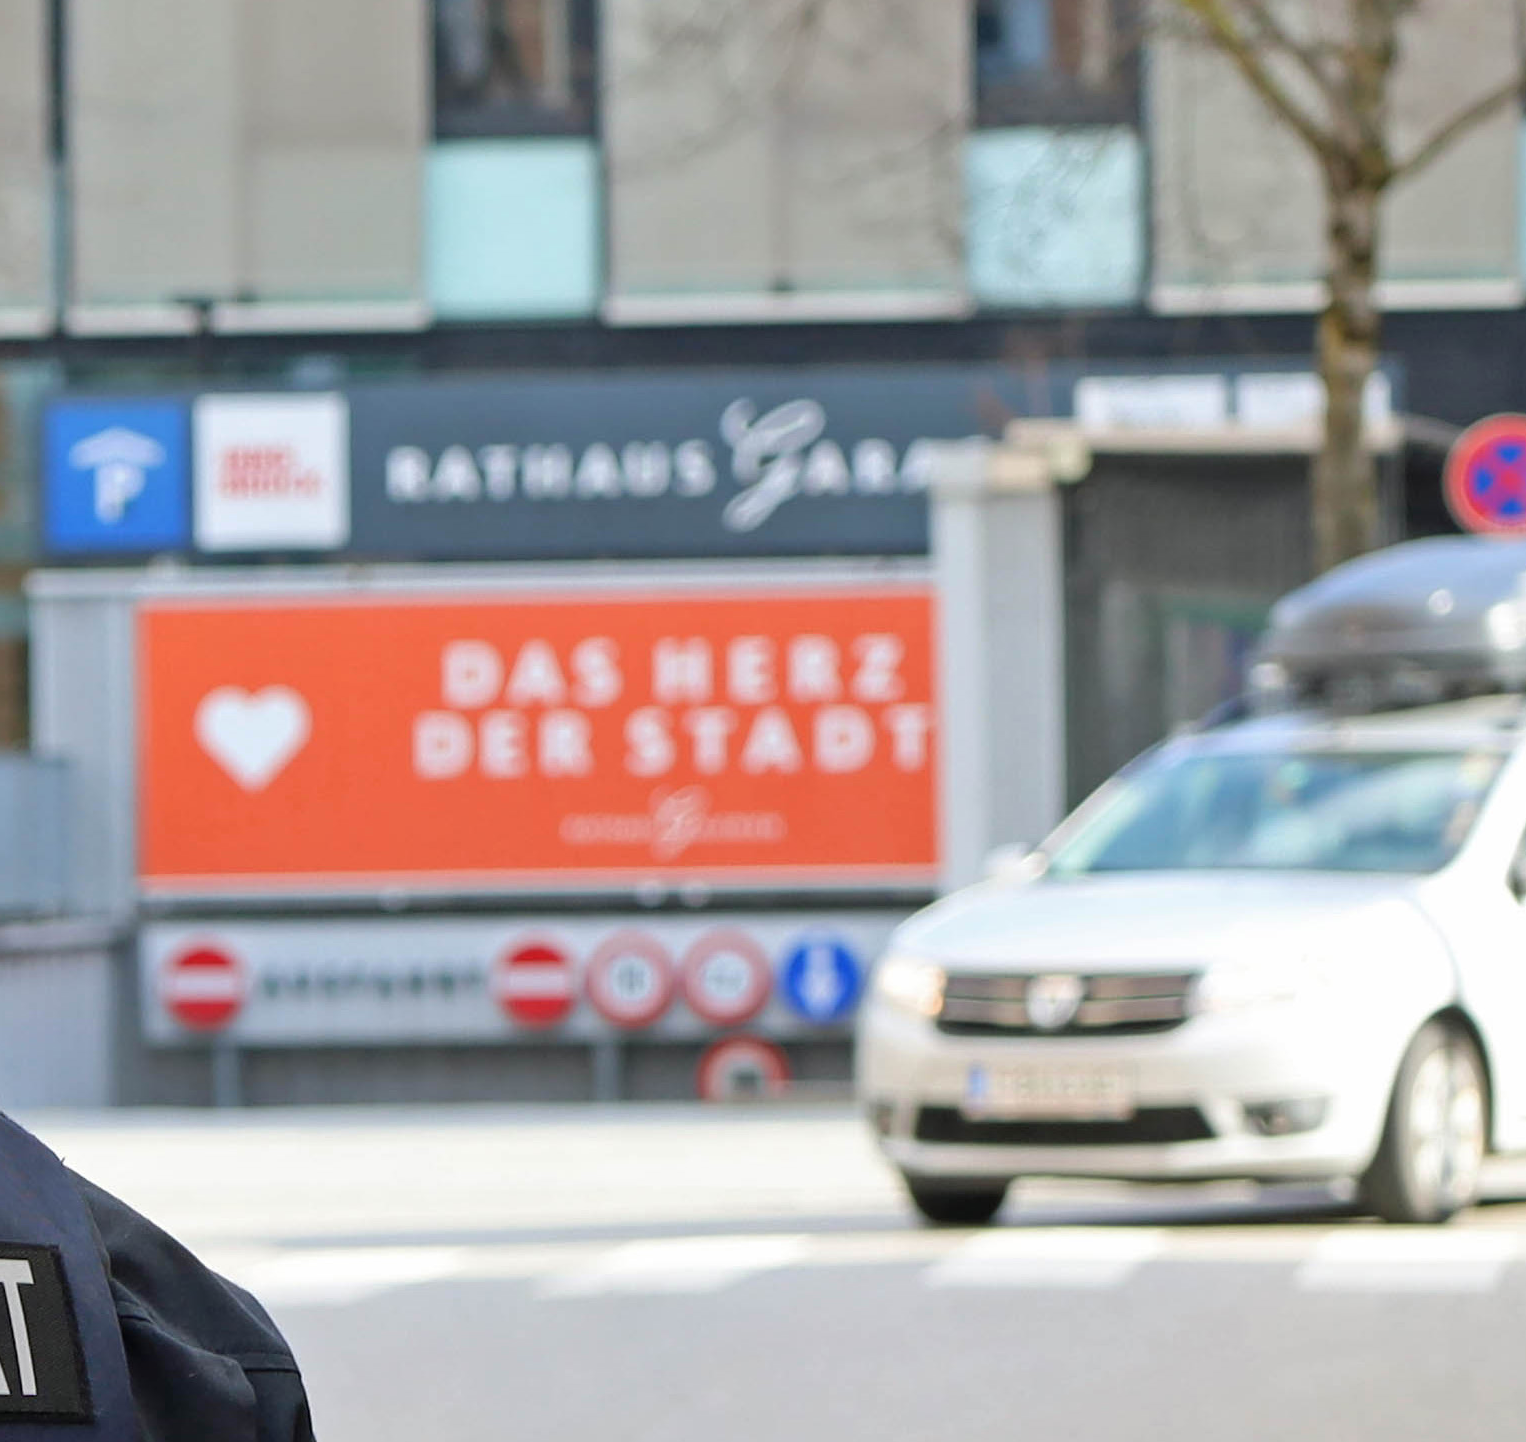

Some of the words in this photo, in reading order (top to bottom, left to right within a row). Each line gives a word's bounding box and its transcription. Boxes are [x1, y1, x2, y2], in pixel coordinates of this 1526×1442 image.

[386, 439, 717, 501] RATHAUS
[440, 637, 624, 709] DAS
[650, 634, 906, 704] HERZ
[412, 707, 595, 780] DER
[623, 702, 934, 777] STADT
